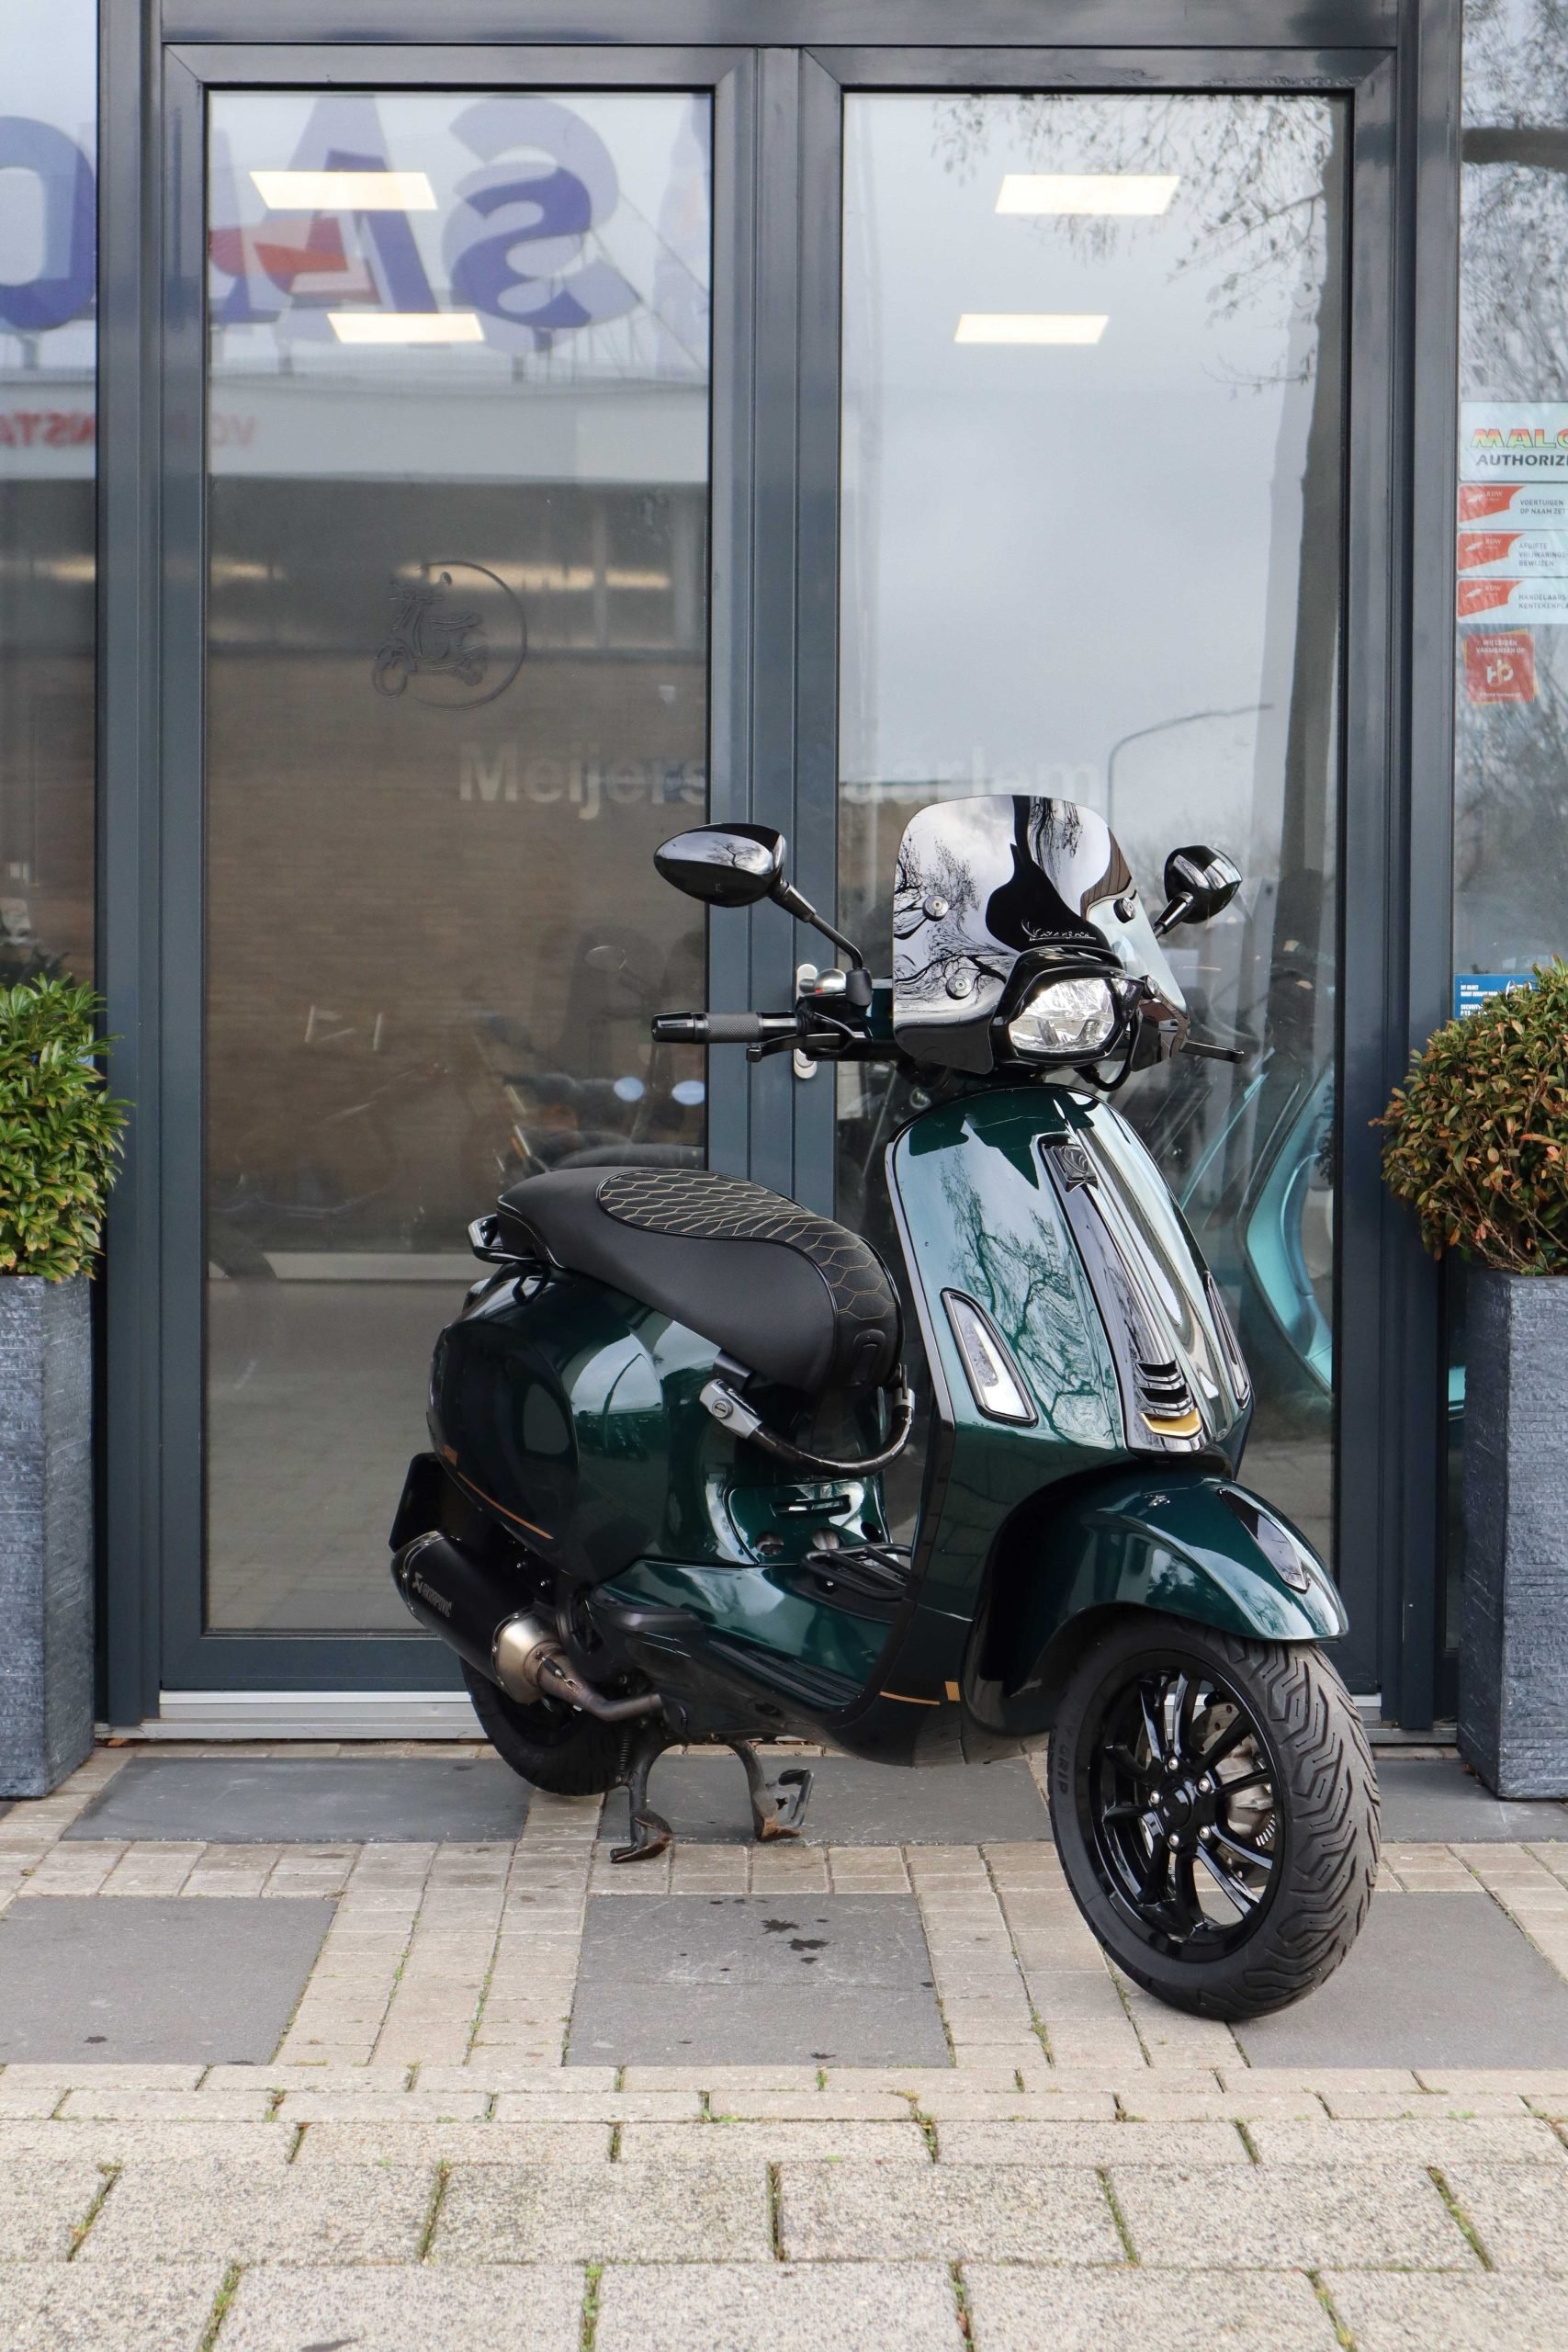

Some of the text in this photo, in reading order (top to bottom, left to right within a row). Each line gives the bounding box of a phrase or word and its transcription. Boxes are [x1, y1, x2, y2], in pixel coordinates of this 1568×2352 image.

[1476, 454, 1568, 467] AUTHORIZ
[458, 741, 1100, 820] Meijers aarlem
